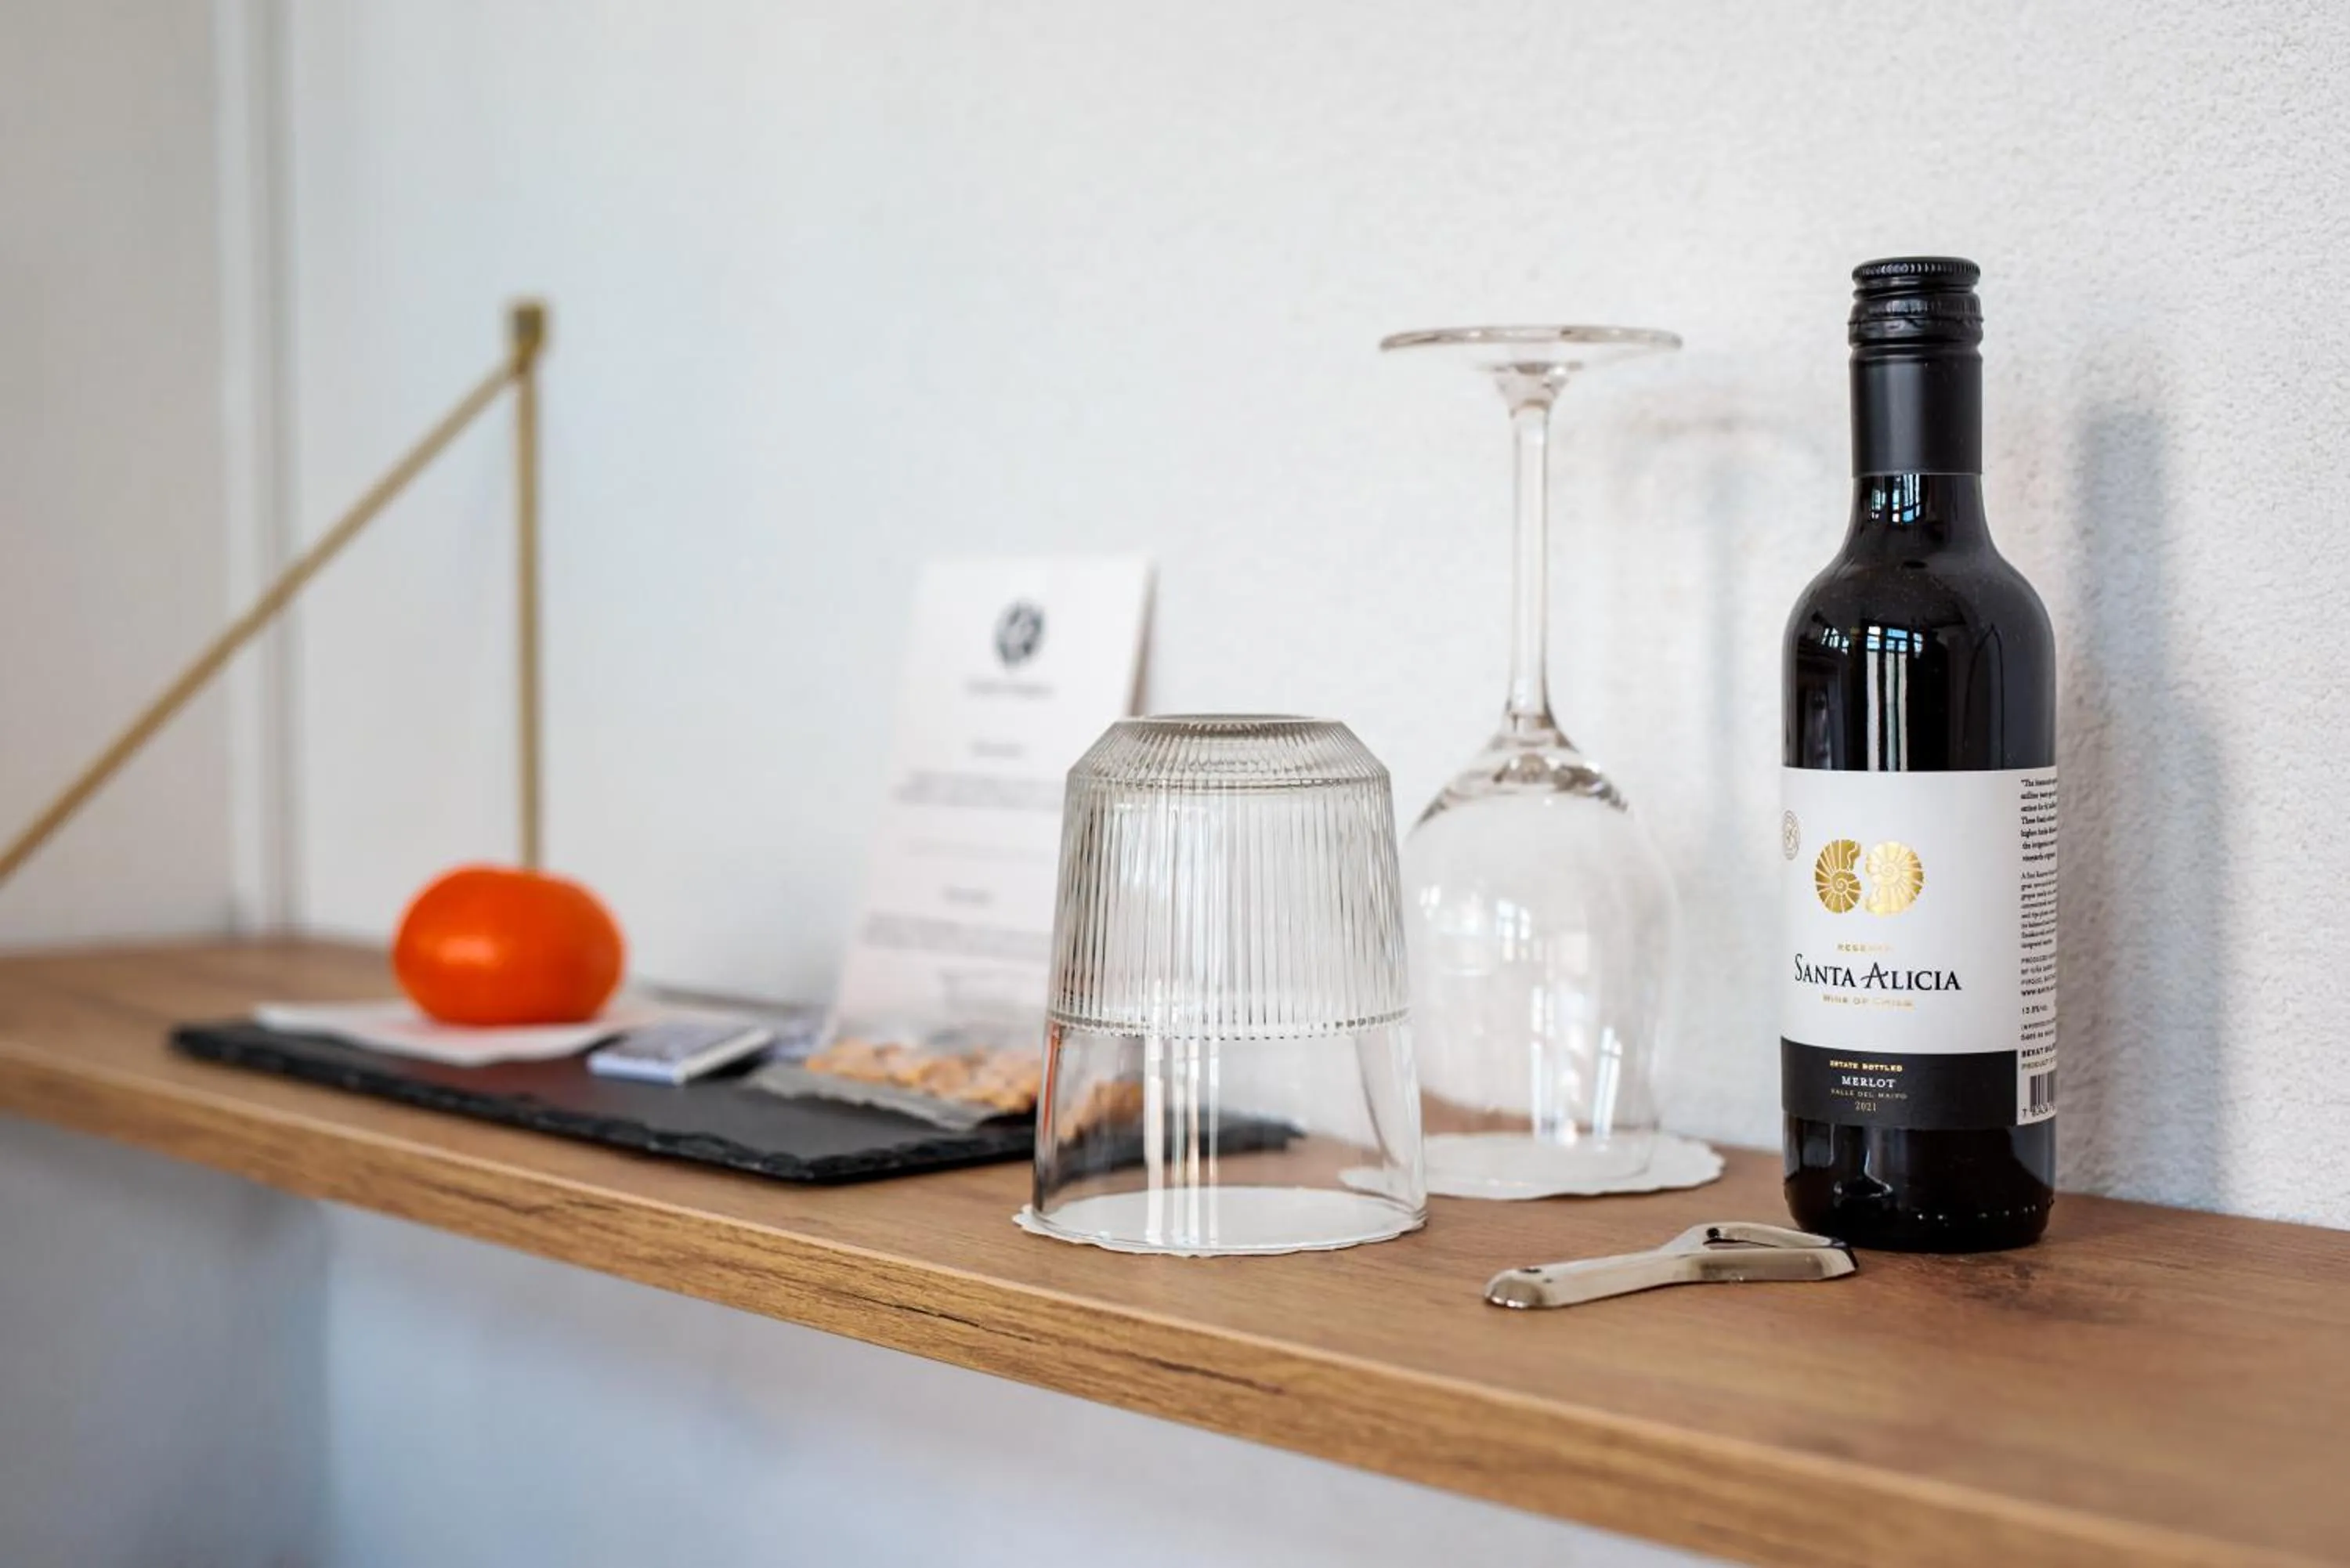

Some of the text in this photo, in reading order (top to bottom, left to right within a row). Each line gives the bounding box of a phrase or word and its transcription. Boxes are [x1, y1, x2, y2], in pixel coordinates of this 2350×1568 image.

[1795, 952, 1962, 991] SANTA ALICIA
[1830, 1060, 1903, 1072] ESTATE BOTTLED
[1842, 1075, 1896, 1088] MERLOT
[1854, 1100, 1877, 1112] 2021
